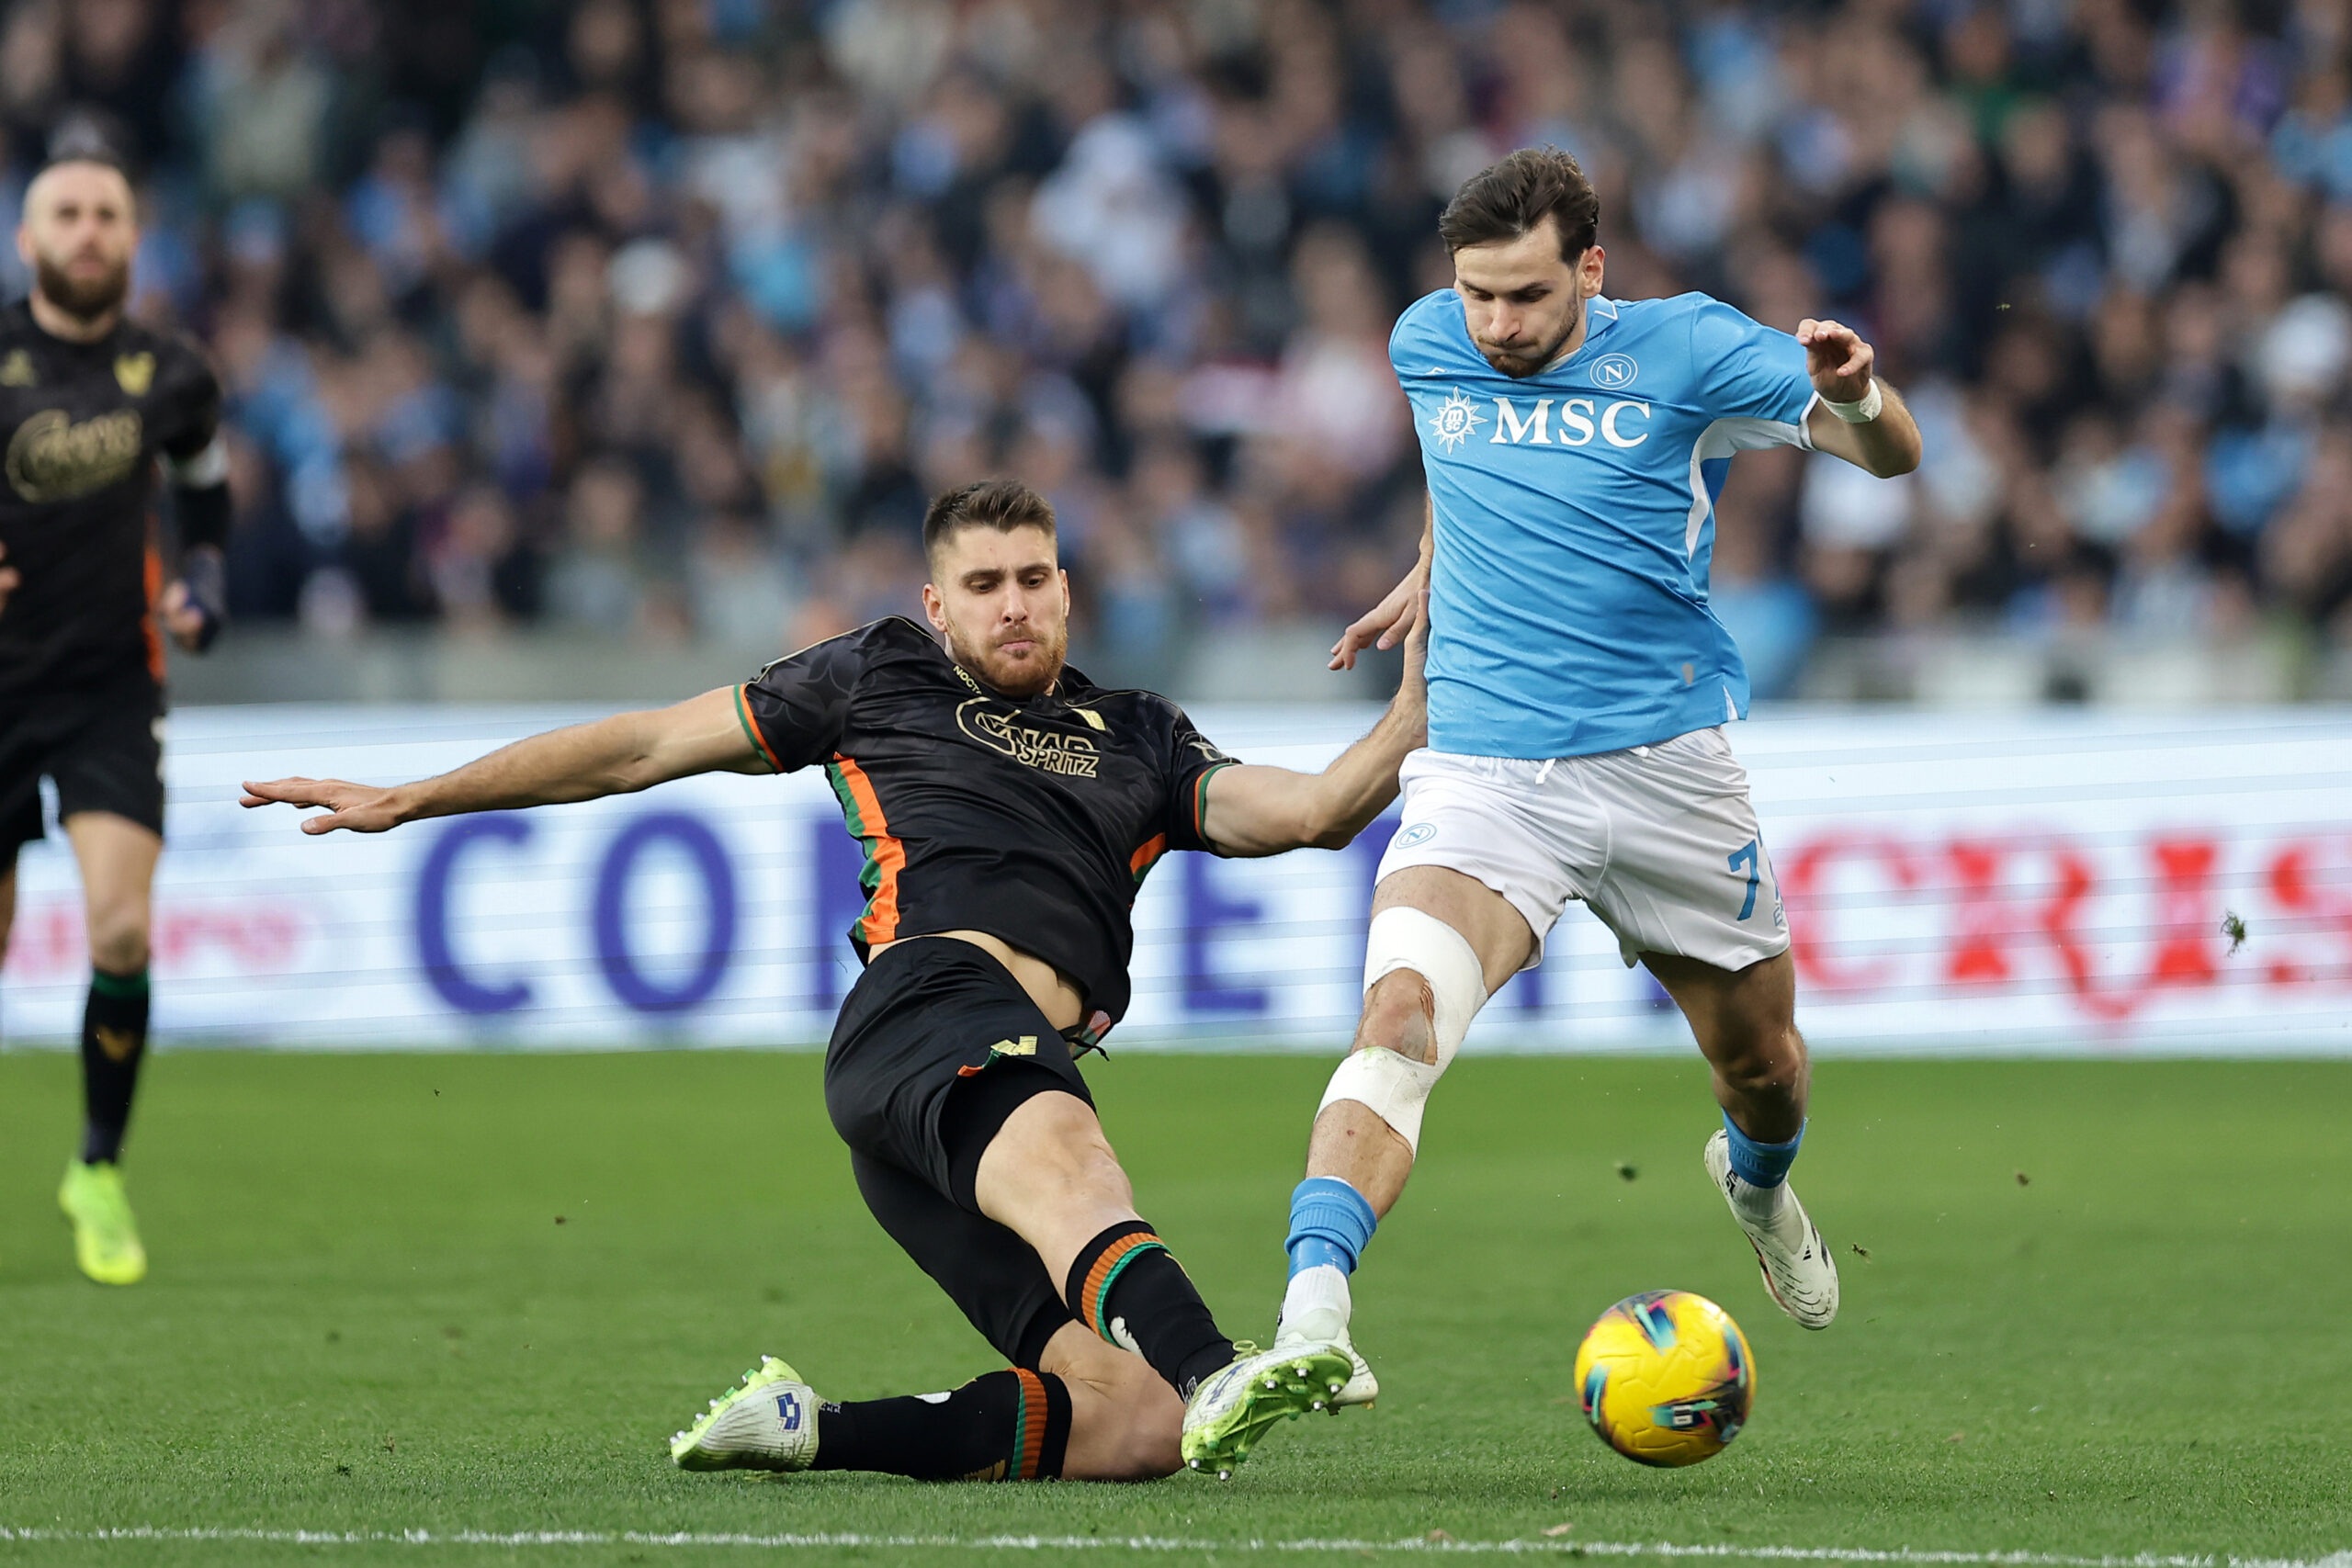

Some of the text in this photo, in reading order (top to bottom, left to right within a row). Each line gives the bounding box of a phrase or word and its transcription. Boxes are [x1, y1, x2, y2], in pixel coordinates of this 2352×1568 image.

[1603, 364, 1623, 382] N
[1489, 397, 1651, 448] MSC
[1016, 743, 1100, 778] SPRITZ
[1727, 839, 1760, 921] 7
